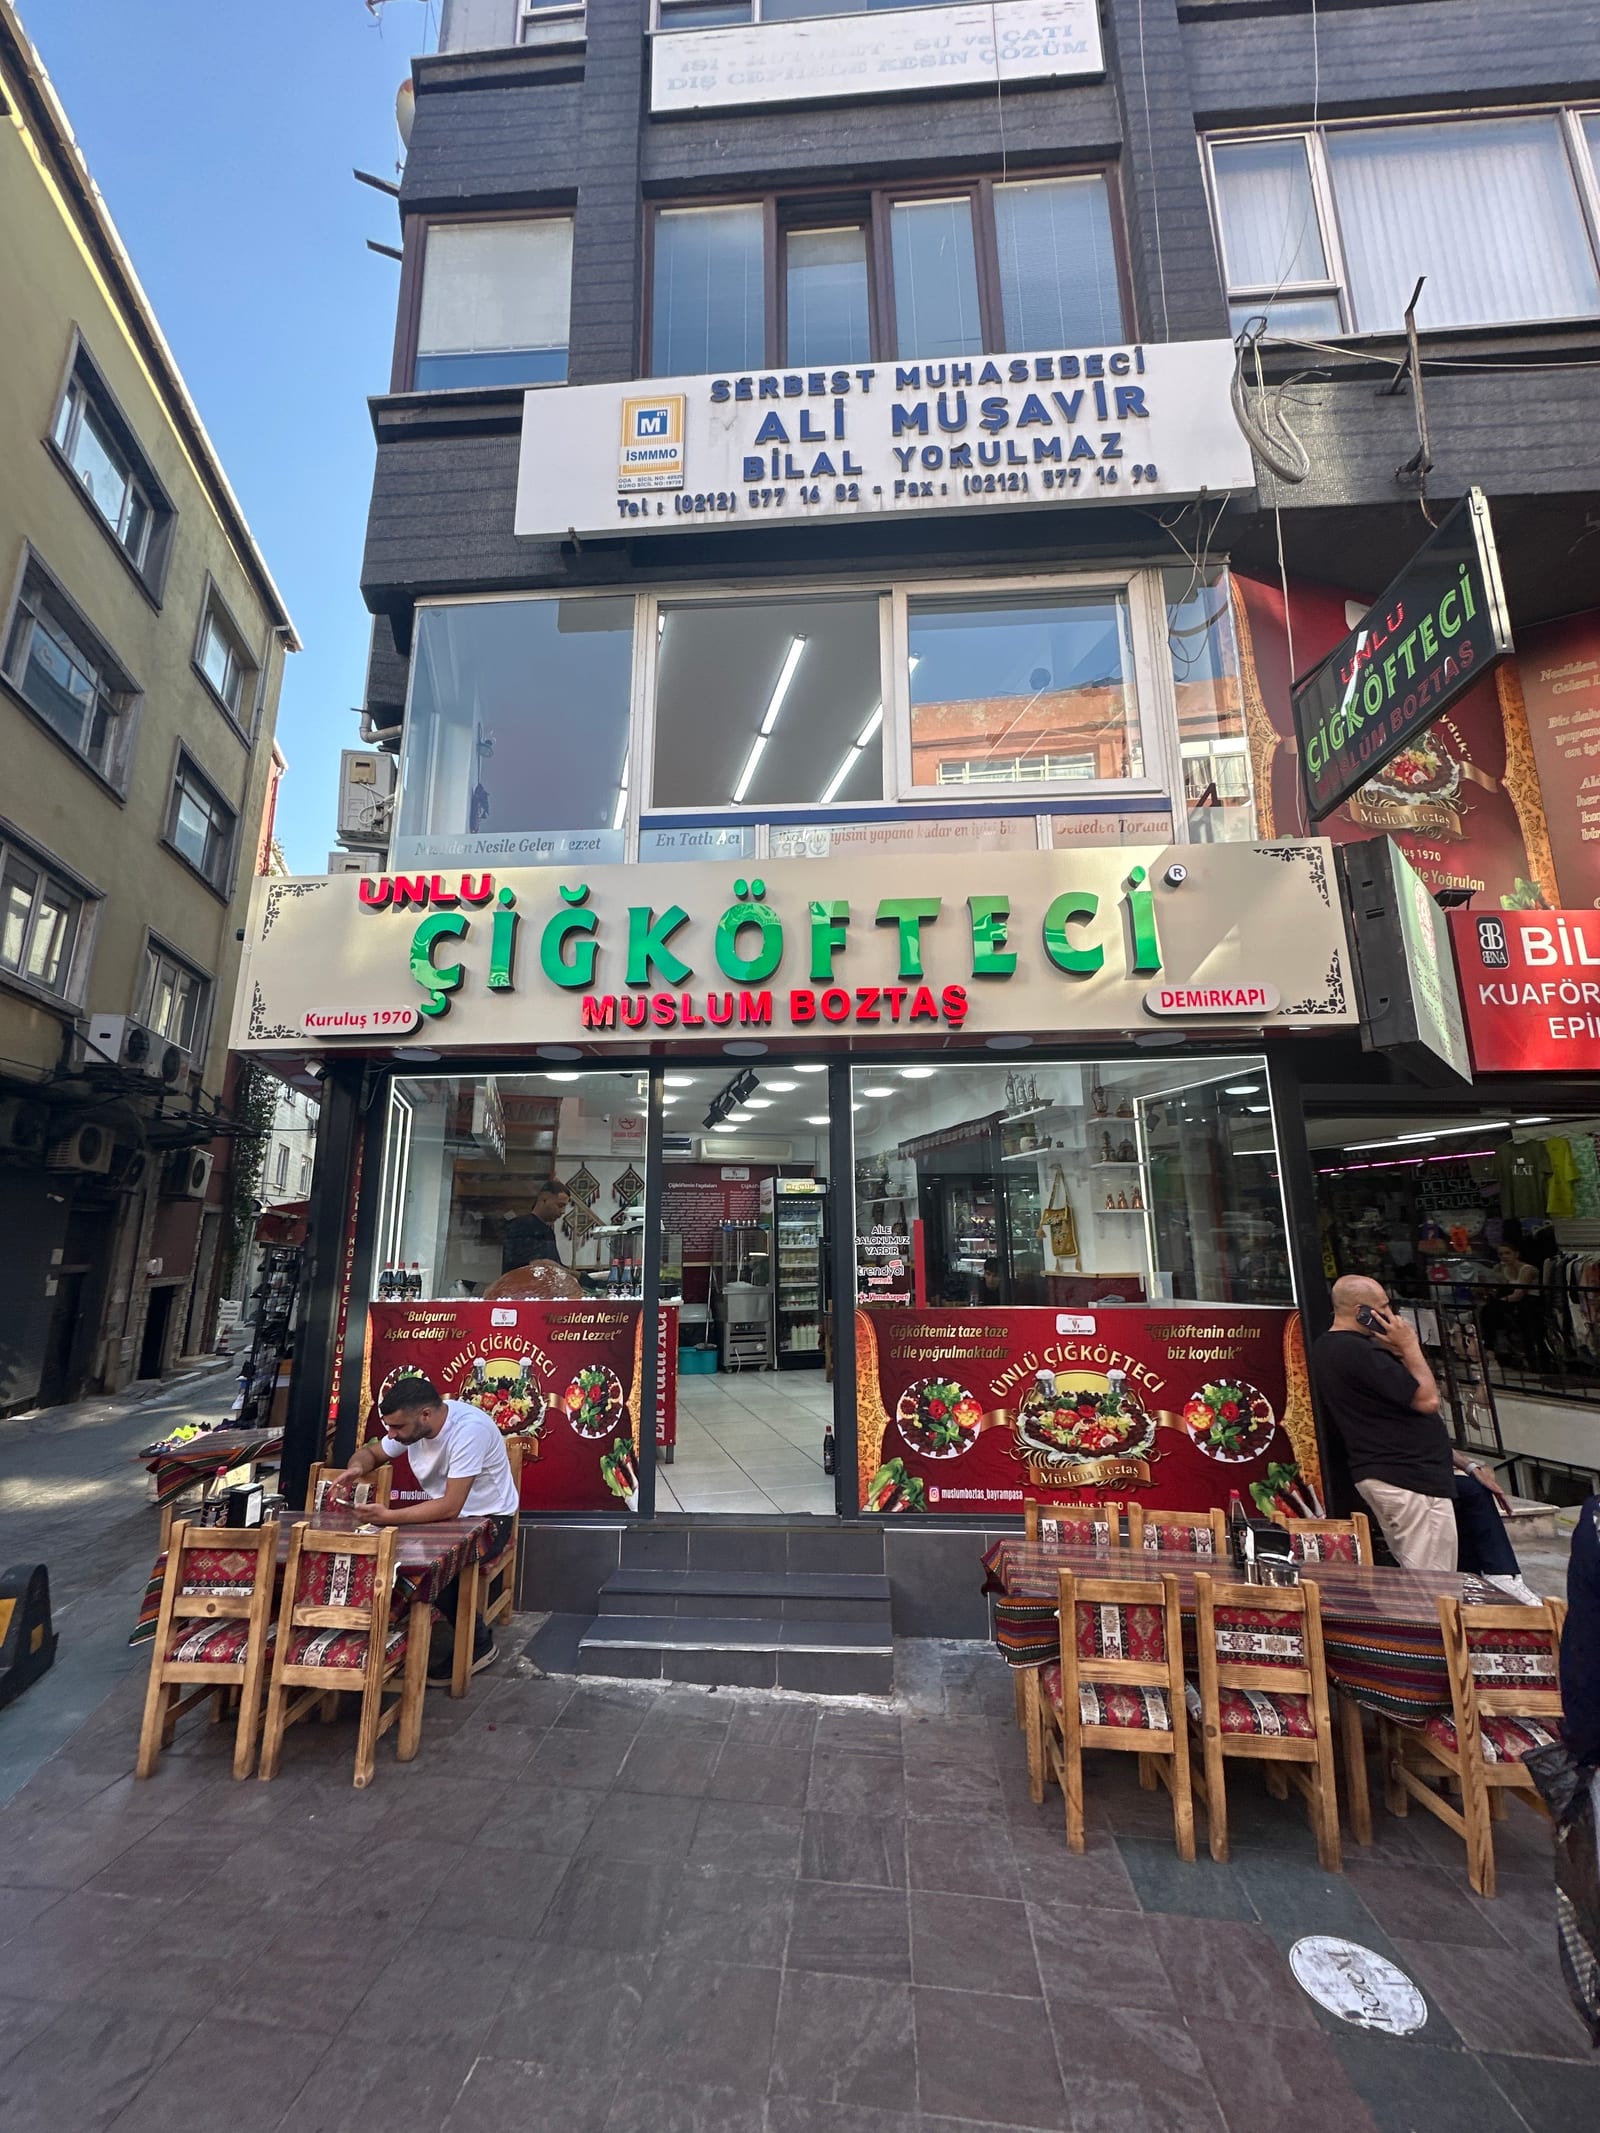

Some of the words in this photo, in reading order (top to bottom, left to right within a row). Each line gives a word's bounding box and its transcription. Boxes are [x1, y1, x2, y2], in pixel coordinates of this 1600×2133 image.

[1003, 24, 1073, 47] ÇATI
[667, 75, 717, 91] DIŞ
[980, 40, 1088, 65] ÇÖZÜM
[710, 369, 875, 402] SERBEST
[896, 346, 1145, 391] MUHASEBECİ
[755, 398, 844, 445] ALİ
[892, 380, 1149, 436] MÜŞAVİR
[626, 448, 678, 462] İSMMMO
[743, 447, 862, 482] BİLAL
[893, 432, 1123, 473] YORULMAZ
[617, 498, 648, 518] Tel
[674, 490, 736, 516] (0212)
[749, 487, 785, 509] 577
[799, 485, 820, 505] 16
[835, 482, 859, 503] 82
[894, 479, 933, 499] Fax
[963, 471, 1029, 496] (0212)
[1042, 467, 1082, 489] 577
[1096, 465, 1118, 485] 16
[1131, 463, 1159, 485] 98
[1307, 562, 1476, 784] ÇİĞKÖFTECİ
[656, 833, 675, 847] En
[680, 831, 712, 847] Tatlı
[954, 826, 968, 838] en
[475, 838, 515, 854] Nesile
[519, 837, 554, 853] Gelen
[1416, 848, 1441, 862] 1970
[1431, 868, 1485, 891] Yoğrulan
[410, 866, 1163, 1017] ÇİĞKÖFTECİ
[790, 984, 970, 1030] BOZTAŞ
[305, 1011, 367, 1029] Kuruluş
[373, 1010, 412, 1025] 1970
[871, 1224, 892, 1235] AİLE
[854, 1235, 911, 1245] SALONUMUZ
[865, 1246, 900, 1256] VARDIR
[596, 1311, 629, 1324] Nesile
[384, 1327, 410, 1342] Aşka
[411, 1326, 449, 1341] Geldiği
[550, 1329, 580, 1341] Gelen
[889, 1324, 956, 1341] Çiğköftemiz
[958, 1325, 982, 1338] taze
[984, 1325, 1009, 1338] taze
[1227, 1324, 1261, 1339] adını
[441, 1341, 477, 1383] ÜNLÜ
[480, 1332, 559, 1378] ÇİĞKÖFTECİ
[890, 1345, 901, 1359] el
[902, 1345, 917, 1359] ile
[918, 1345, 1009, 1362] yoğrulmaktadır
[1167, 1345, 1186, 1360] biz
[989, 1350, 1040, 1398] ÜNLÜ
[1043, 1341, 1168, 1394] ÇİĞKÖFTECİ
[1039, 1468, 1094, 1485] Müslüm
